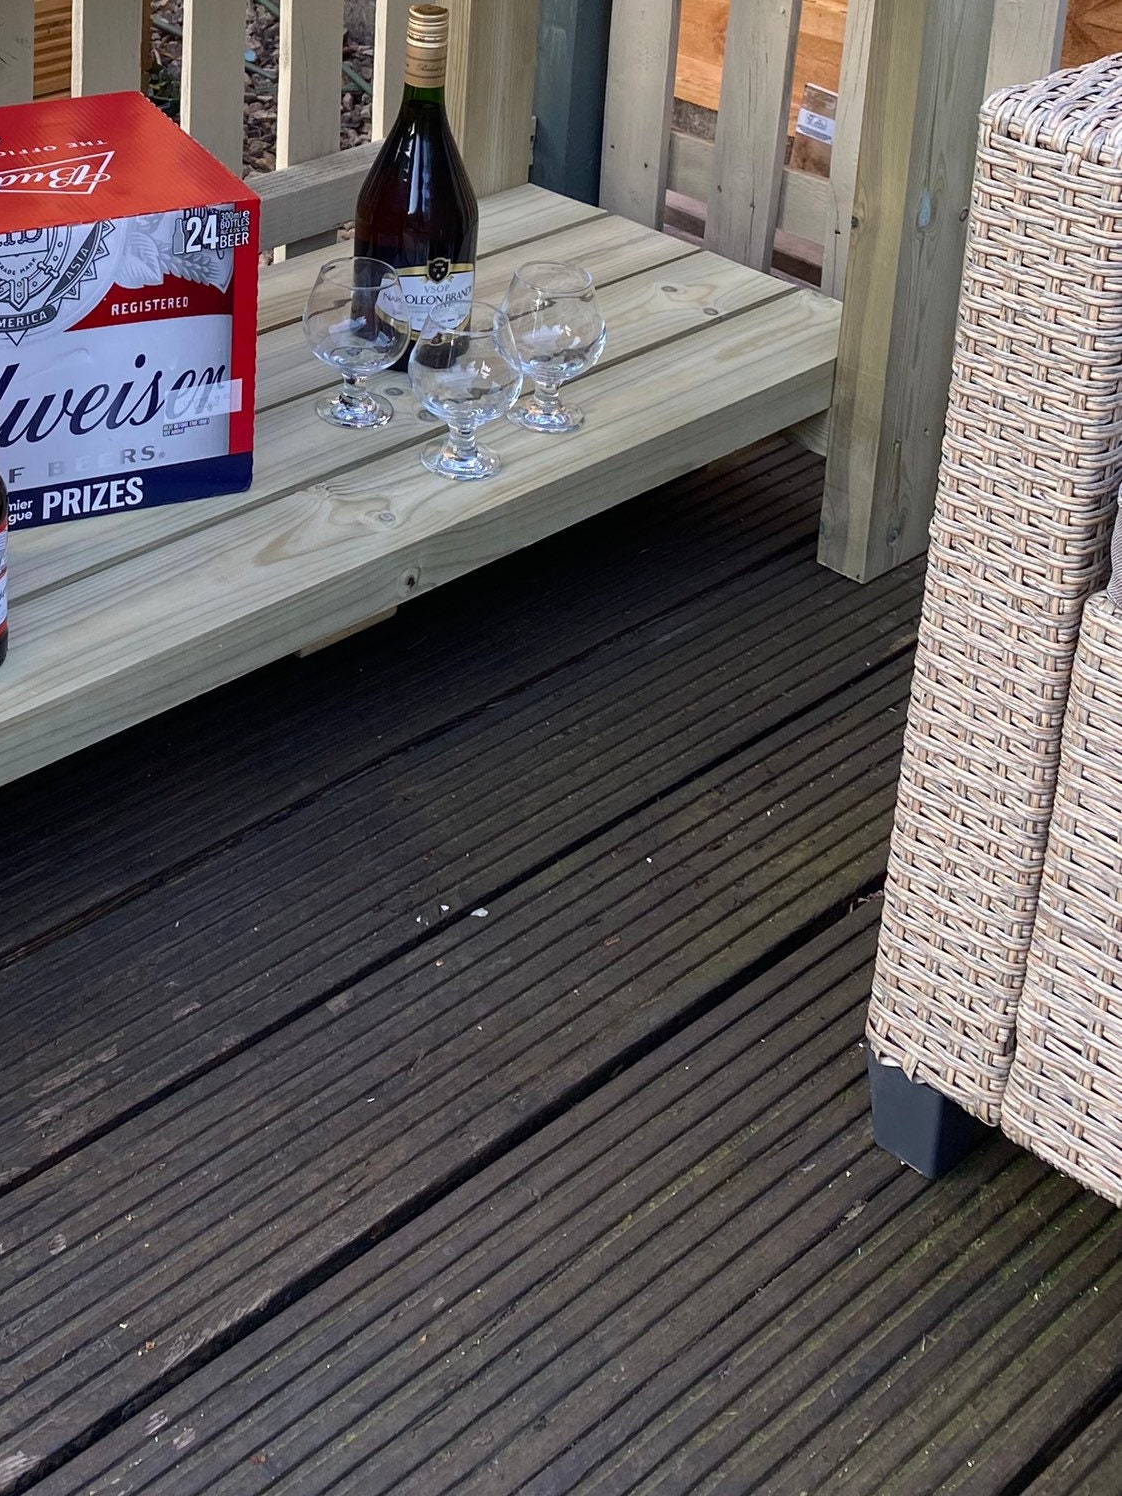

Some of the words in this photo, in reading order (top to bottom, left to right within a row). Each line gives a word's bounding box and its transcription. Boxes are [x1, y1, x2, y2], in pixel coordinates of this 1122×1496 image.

[65, 139, 108, 149] THE
[220, 217, 250, 230] BOTTLES
[185, 214, 219, 253] 24
[219, 231, 250, 249] BEER
[19, 256, 37, 274] MARK
[65, 247, 90, 280] ASIA
[423, 284, 451, 294] VSOP
[445, 285, 472, 302] BRAND
[111, 295, 189, 316] REGISTERED
[8, 499, 34, 511] mier
[42, 476, 144, 521] PRIZES
